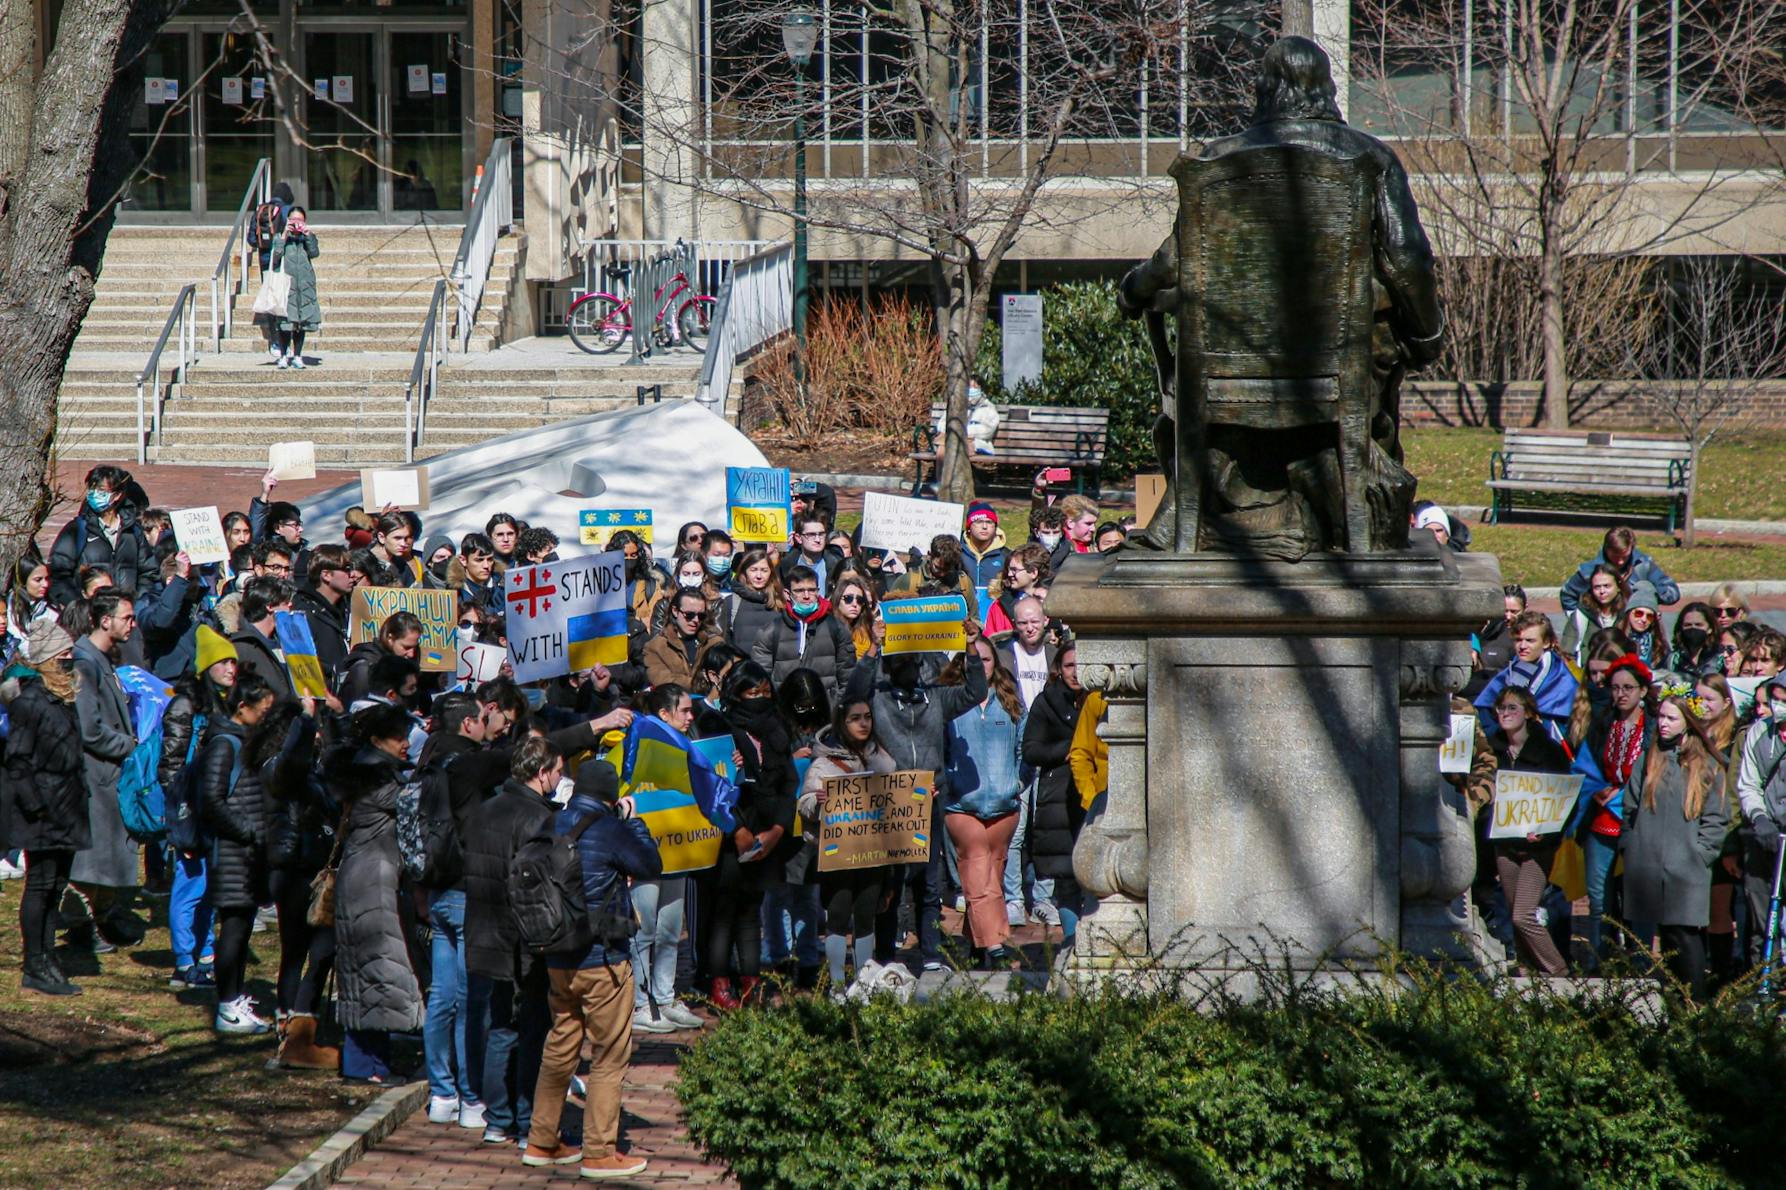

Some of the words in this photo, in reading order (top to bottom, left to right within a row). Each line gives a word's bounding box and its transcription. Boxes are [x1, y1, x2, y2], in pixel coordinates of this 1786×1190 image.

[184, 511, 210, 525] STAND
[188, 525, 211, 536] WITH
[561, 564, 622, 602] STANDS
[418, 622, 459, 650] АМИ
[888, 634, 912, 642] GLORY
[914, 633, 924, 641] TO
[926, 632, 960, 640] UKRAINE!
[509, 632, 563, 665] WITH
[826, 776, 872, 797] FIRST
[880, 773, 917, 790] THEY
[1498, 774, 1543, 795] STAND
[1545, 776, 1580, 795] WITH
[824, 796, 863, 814] CAME
[869, 792, 896, 809] FOR
[890, 805, 913, 819] AND
[918, 802, 925, 818] I
[1495, 796, 1573, 828] UKRAINE
[666, 832, 683, 847] TO
[823, 827, 843, 840] DID
[847, 824, 868, 837] NOT
[871, 821, 906, 835] SPEAK
[906, 819, 928, 831] OUT
